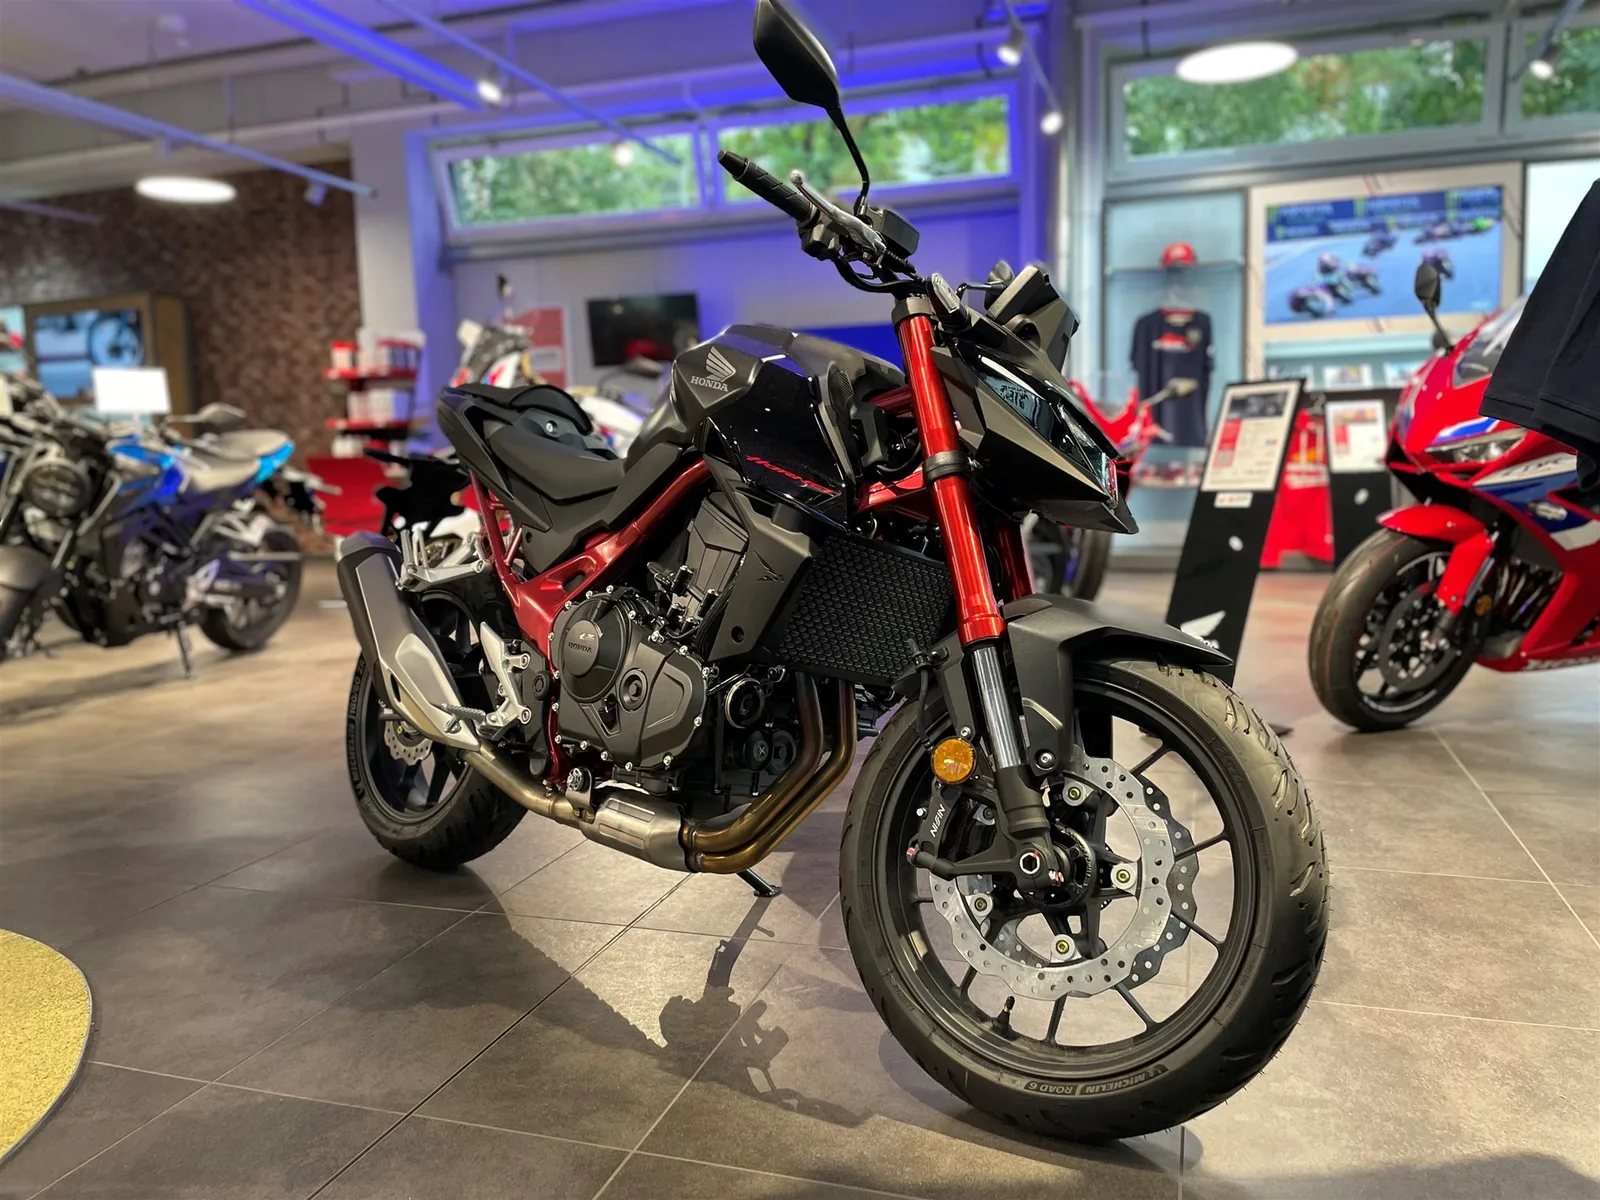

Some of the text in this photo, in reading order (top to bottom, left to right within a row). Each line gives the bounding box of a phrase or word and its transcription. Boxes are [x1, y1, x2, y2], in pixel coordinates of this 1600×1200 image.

[690, 375, 729, 393] HONDA
[568, 641, 592, 654] HONDA
[930, 803, 946, 838] NISSIN
[1028, 1073, 1146, 1095] MICHELIN ROAD 6
